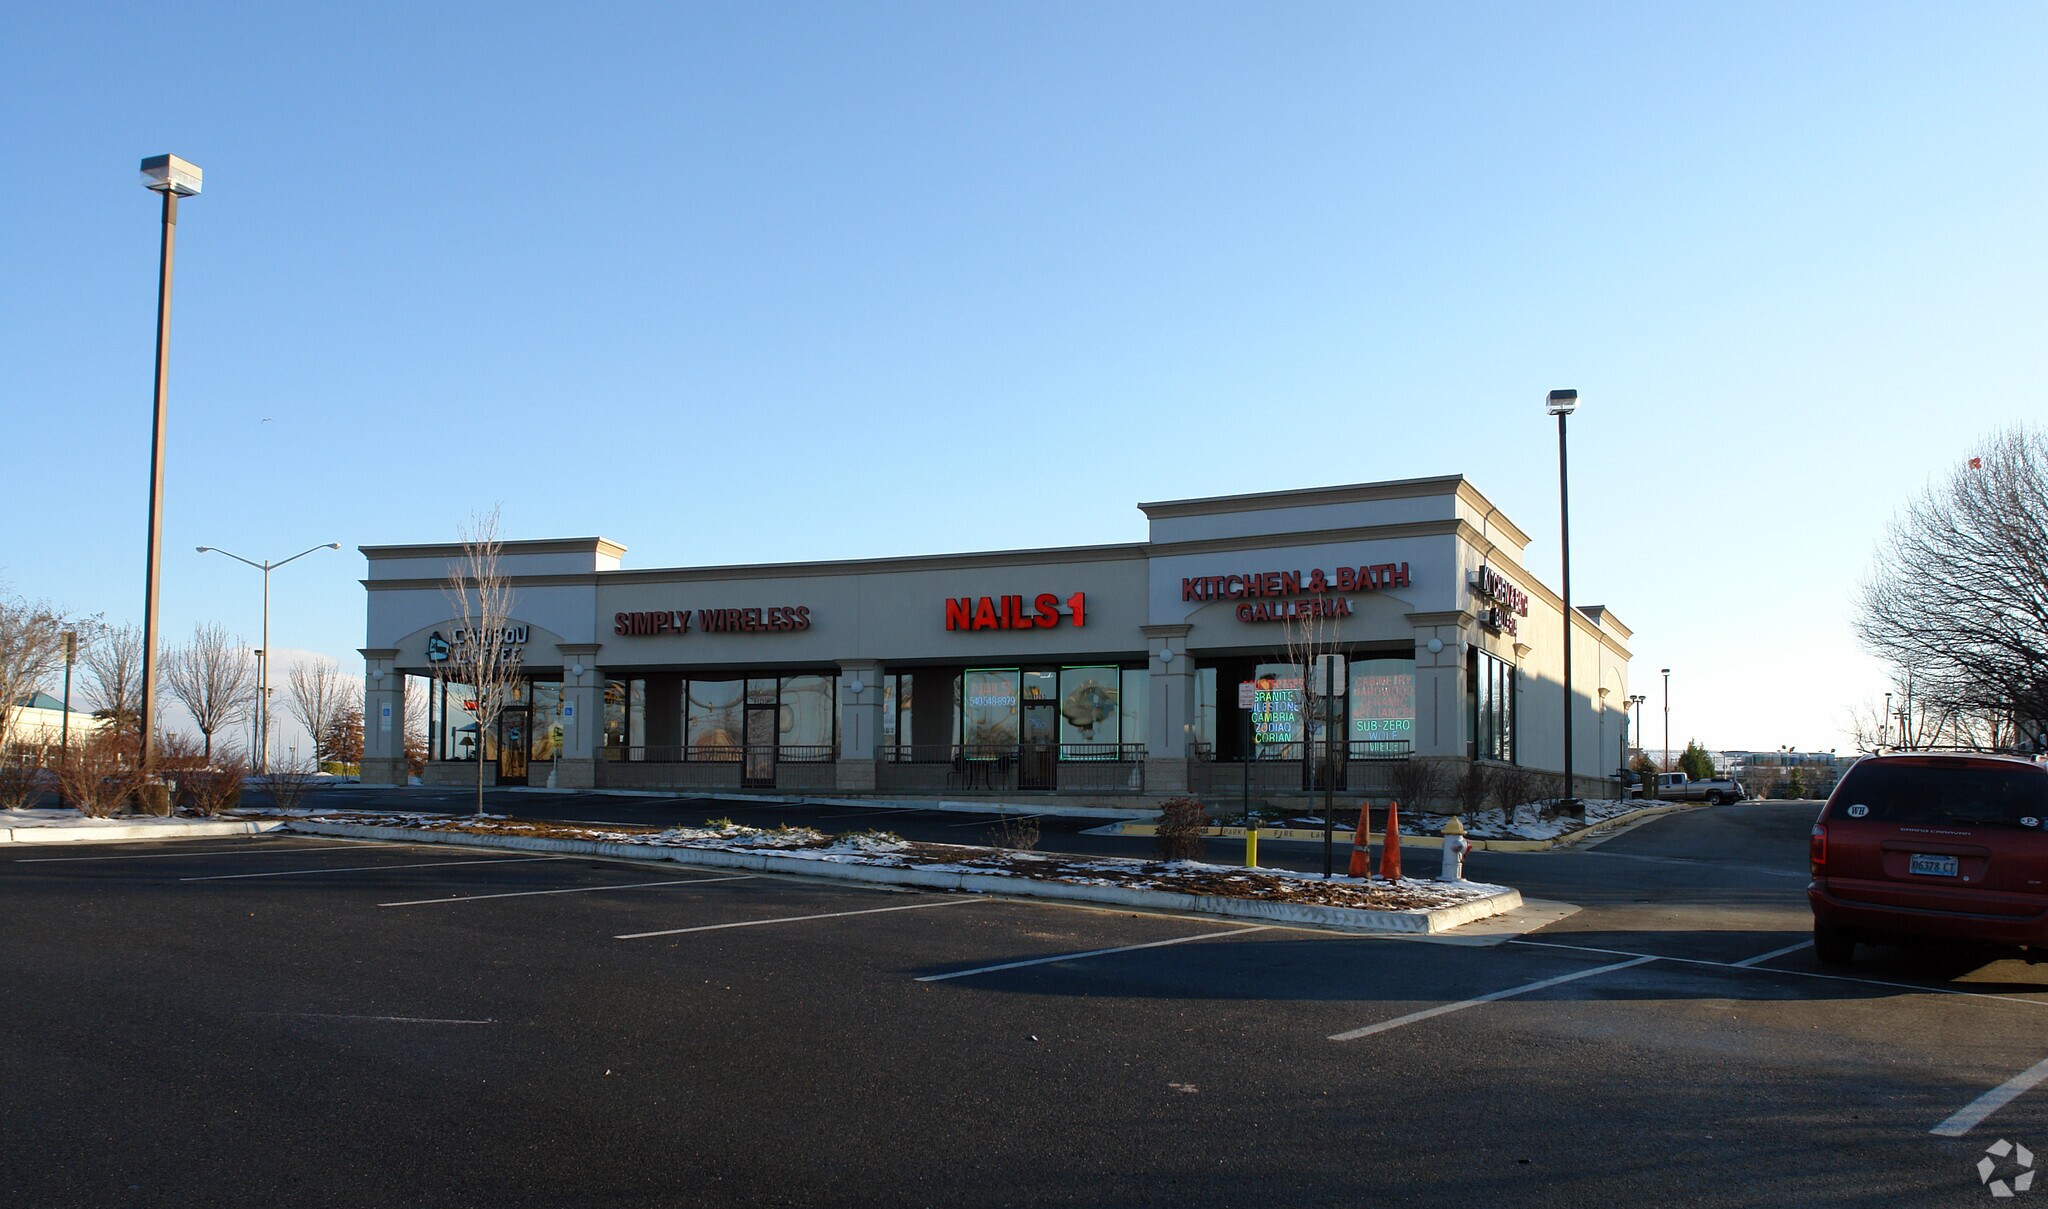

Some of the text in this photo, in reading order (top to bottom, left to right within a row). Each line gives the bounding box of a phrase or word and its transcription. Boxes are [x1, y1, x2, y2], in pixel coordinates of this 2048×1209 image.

[1182, 562, 1409, 600] KITCHEN & BATH
[945, 592, 1085, 631] NAILS 1
[1235, 597, 1350, 622] GALLERIA
[614, 606, 810, 636] SIMPLY WIRELESS
[1251, 712, 1295, 723] CAMBRIA
[1255, 722, 1292, 733] ZODIAQ
[1357, 719, 1411, 732] SUB-ZERO
[1255, 732, 1292, 743] CORIAN
[1368, 730, 1398, 741] WOLF
